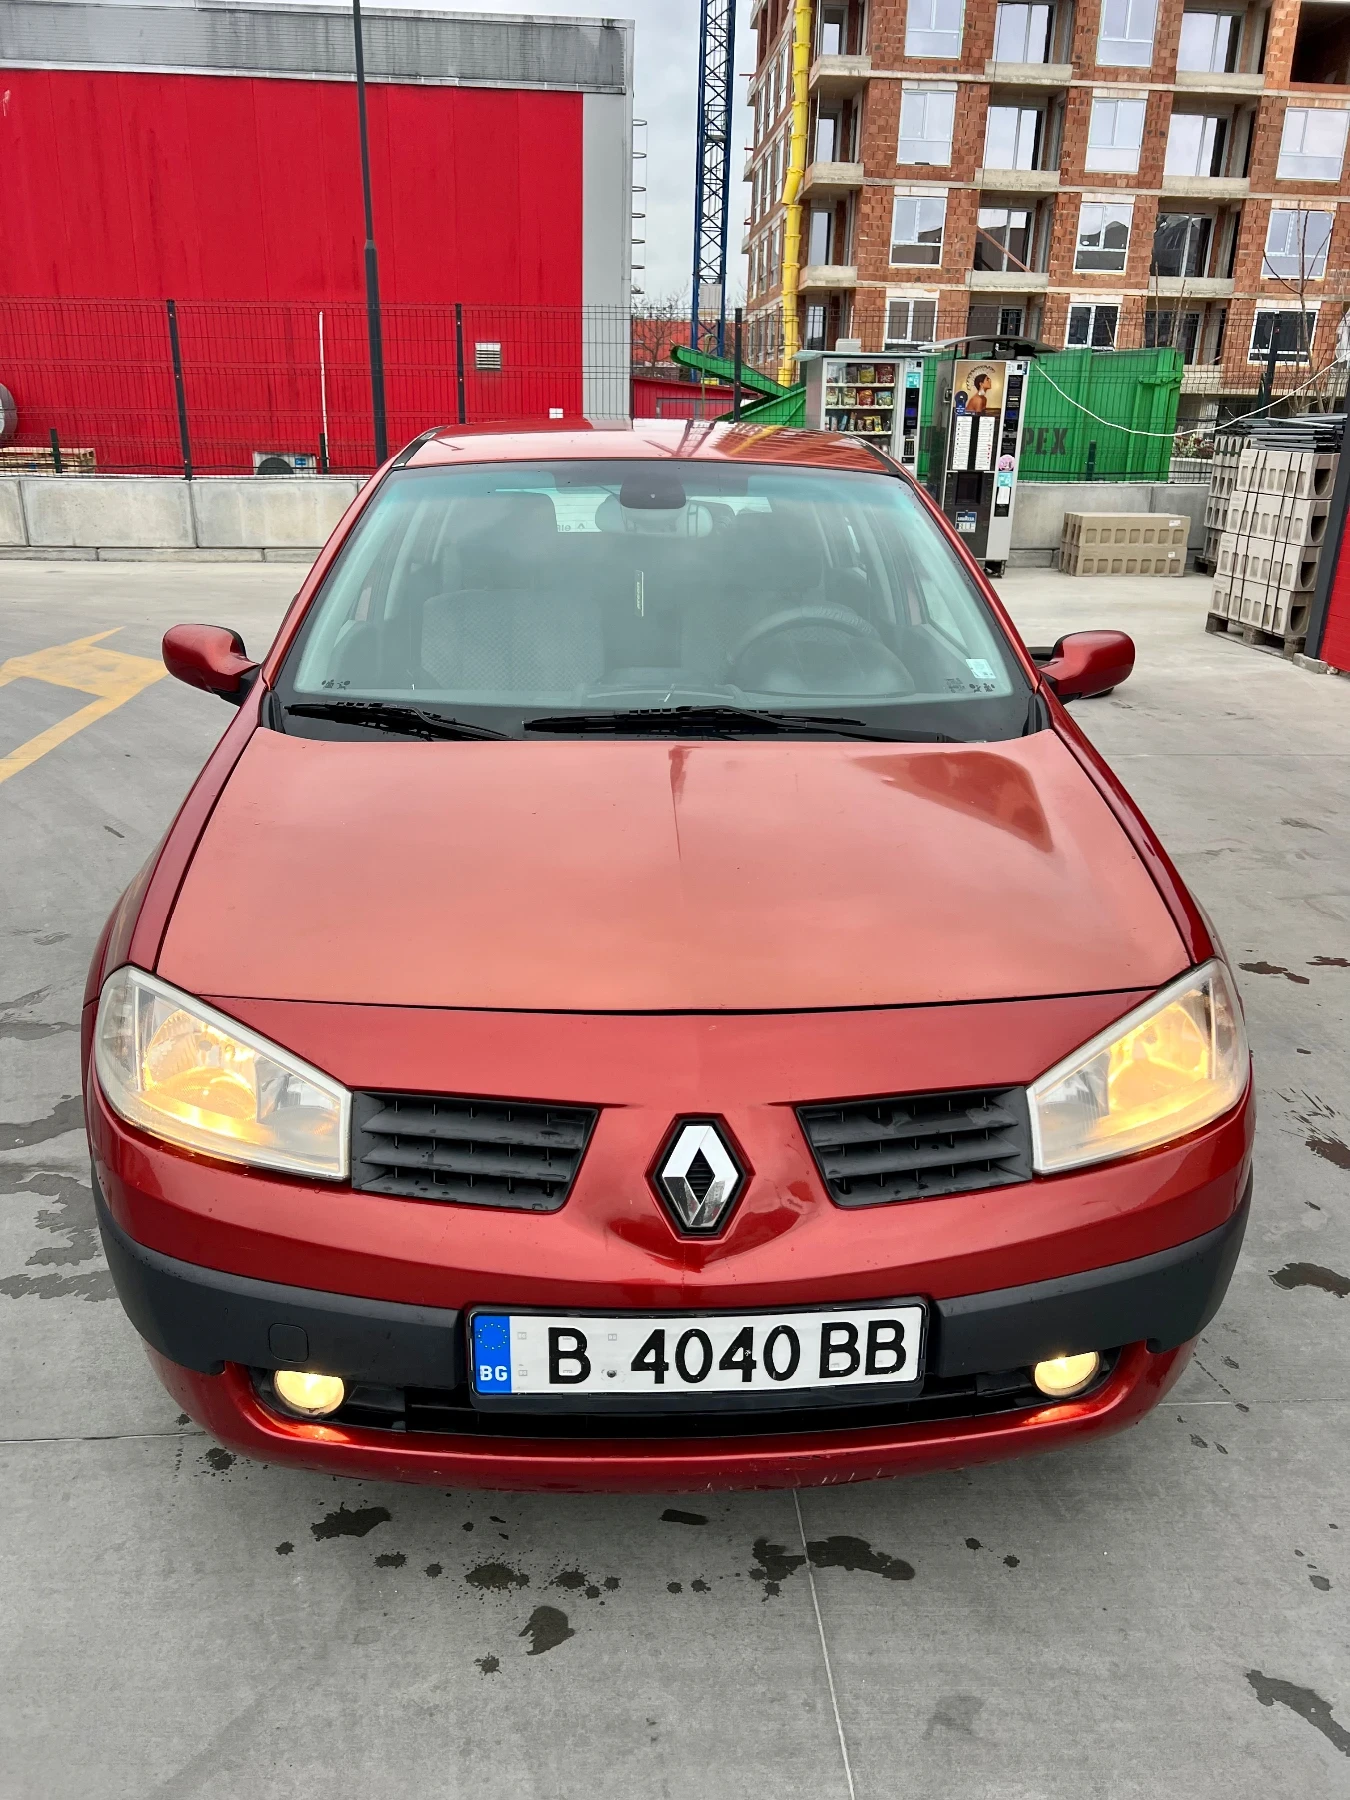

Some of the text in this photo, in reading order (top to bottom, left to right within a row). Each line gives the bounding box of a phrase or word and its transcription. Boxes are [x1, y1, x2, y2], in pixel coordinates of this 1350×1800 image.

[548, 1319, 907, 1384] B 4040 BB
[479, 1365, 508, 1382] BG
